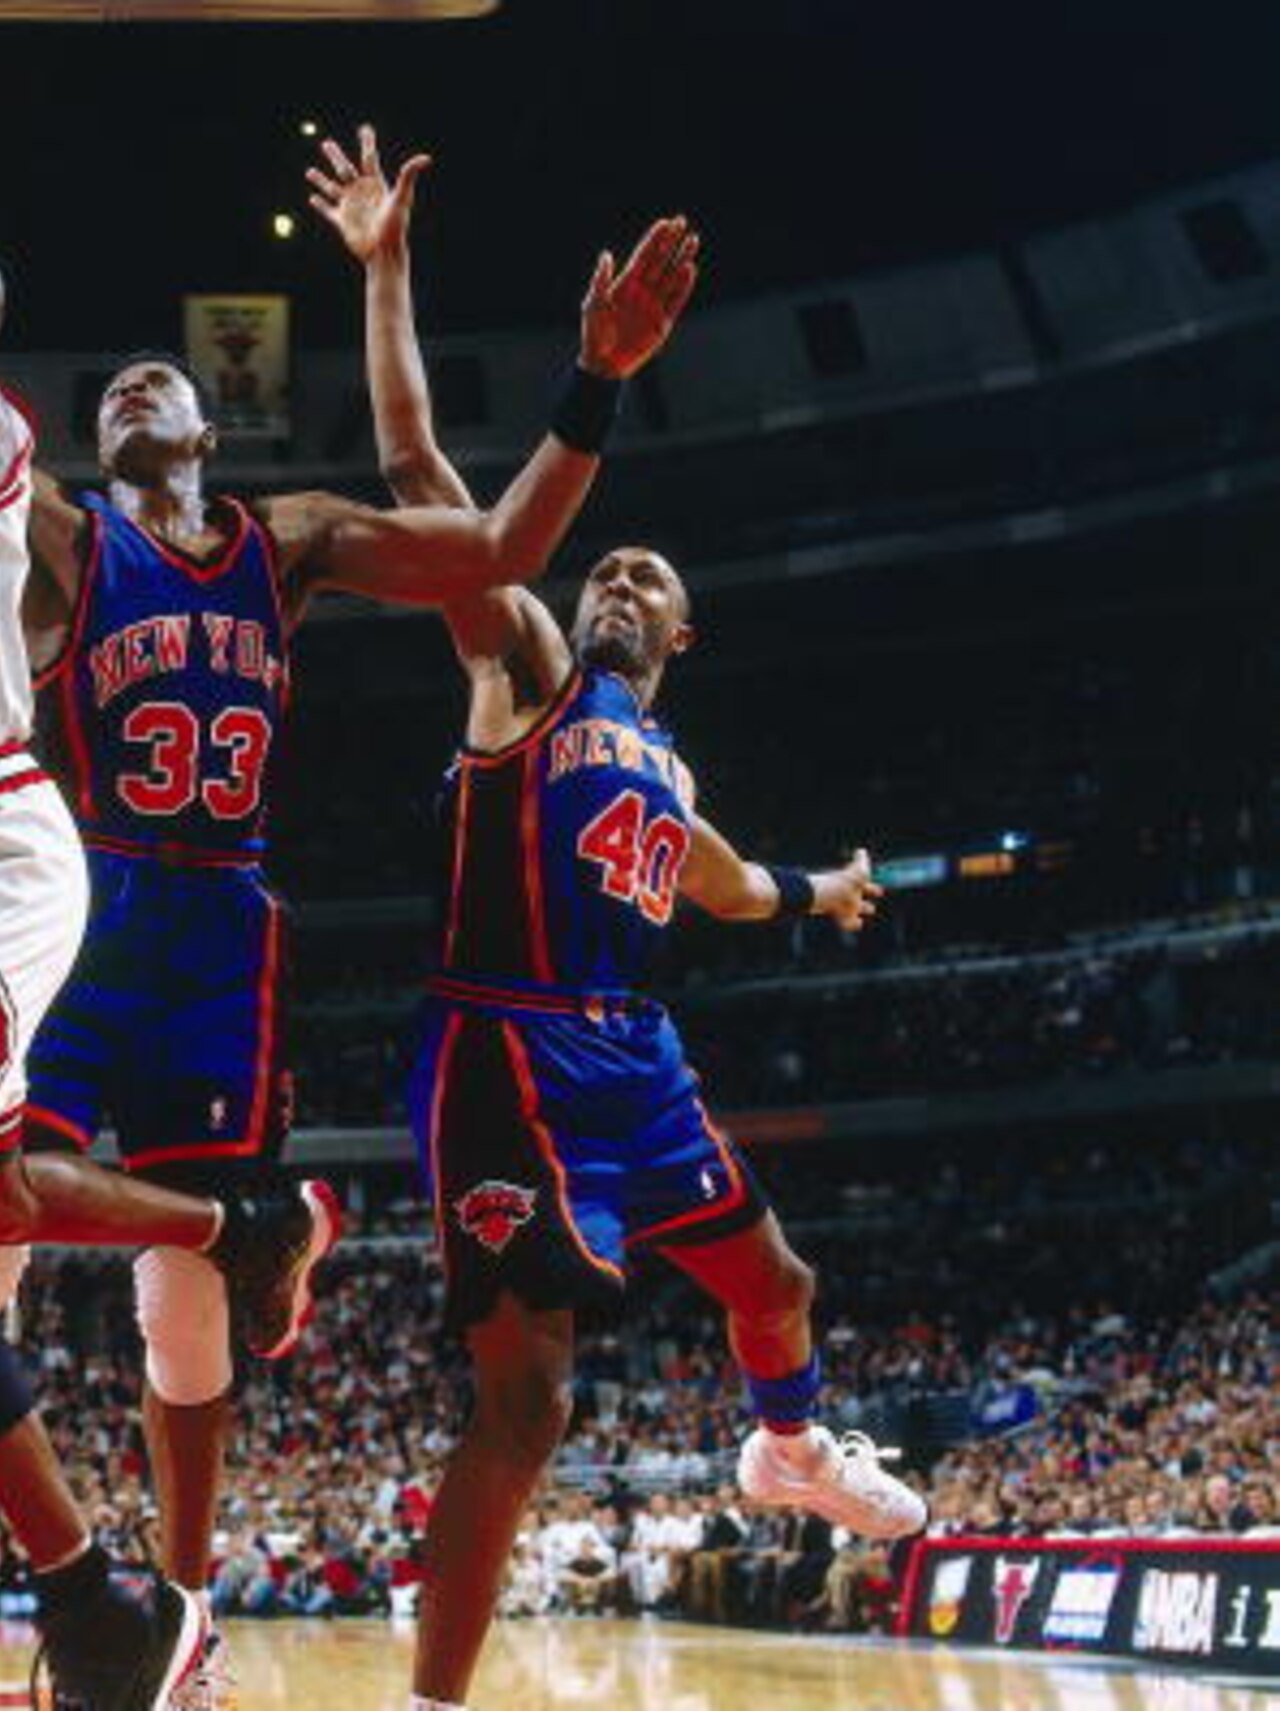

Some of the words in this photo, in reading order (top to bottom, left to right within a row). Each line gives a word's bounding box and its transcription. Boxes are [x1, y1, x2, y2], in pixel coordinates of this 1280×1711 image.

[90, 612, 190, 708] NEW
[117, 702, 271, 820] 33
[548, 719, 644, 783] NEW
[578, 788, 690, 926] 40
